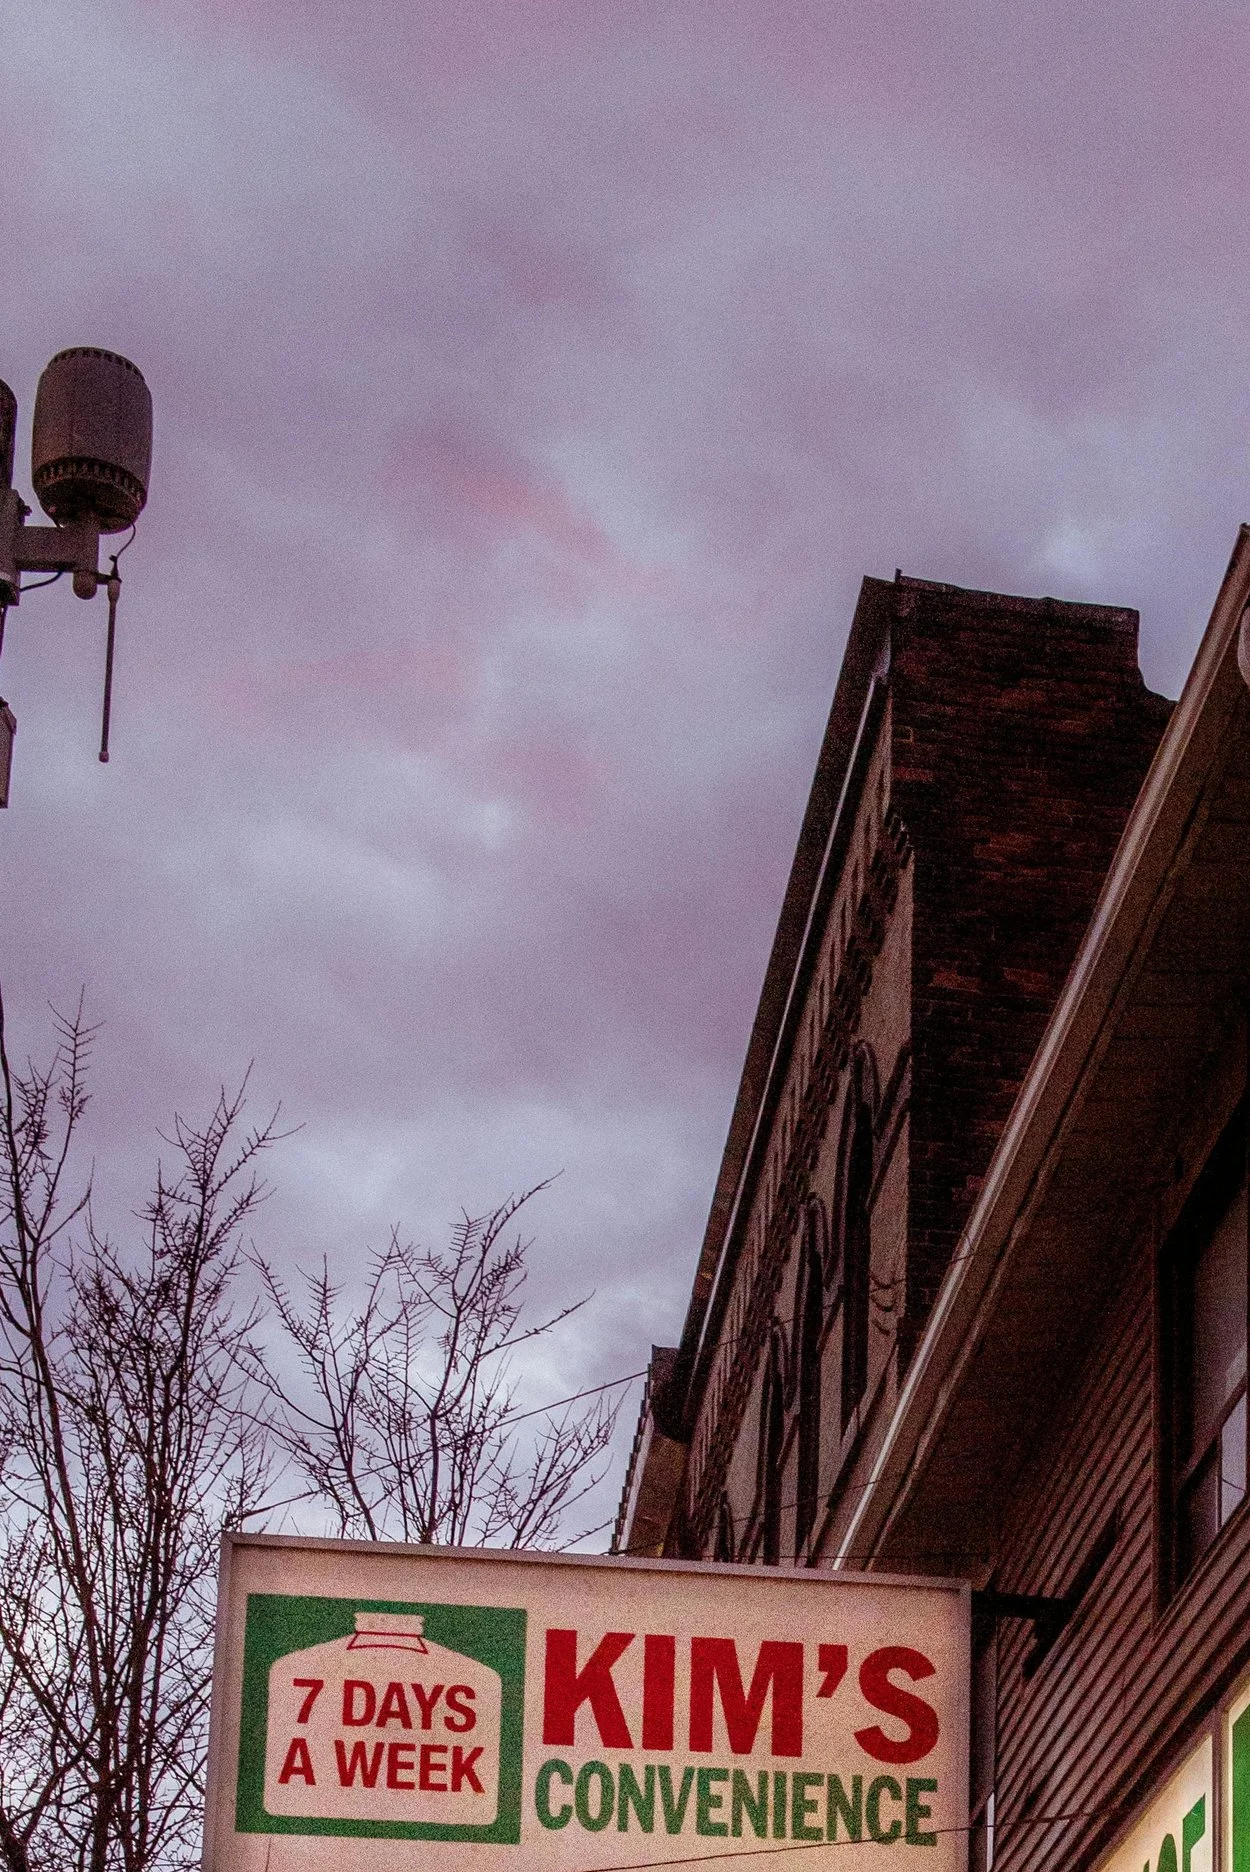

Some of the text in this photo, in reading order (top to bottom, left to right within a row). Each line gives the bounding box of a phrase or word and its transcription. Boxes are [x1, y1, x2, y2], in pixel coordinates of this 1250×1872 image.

[292, 1678, 477, 1733] 7 DAYS
[542, 1628, 941, 1765] KIM'S
[278, 1738, 485, 1794] A WEEK
[534, 1757, 938, 1848] CONVENIENCE
